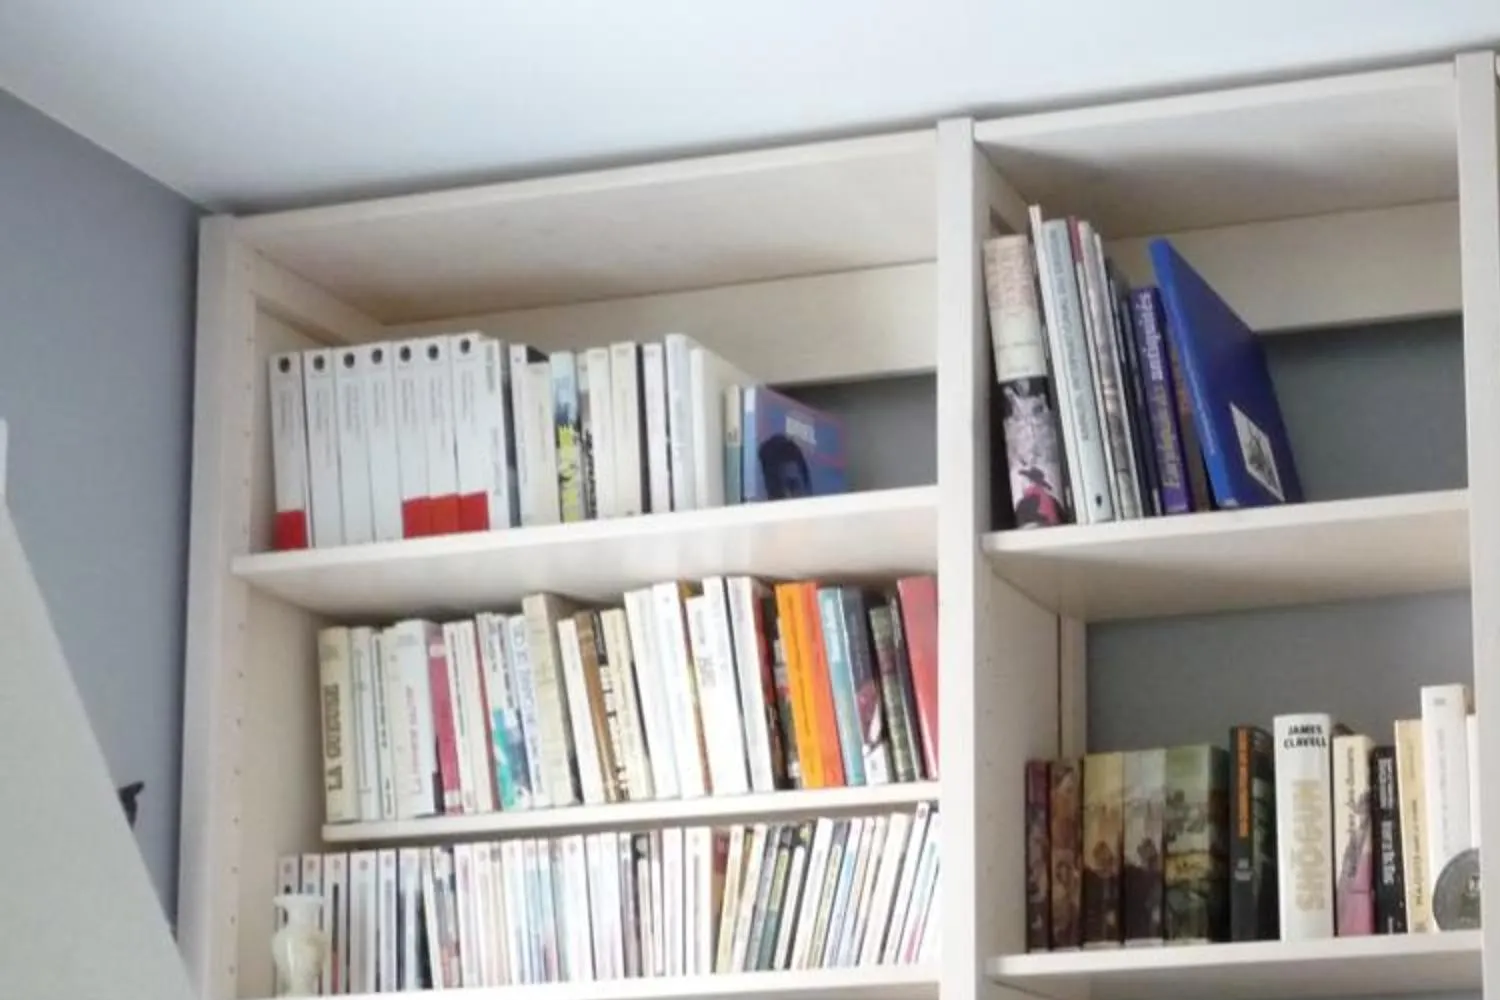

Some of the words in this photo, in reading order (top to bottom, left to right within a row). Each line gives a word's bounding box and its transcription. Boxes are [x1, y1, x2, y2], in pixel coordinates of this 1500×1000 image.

[1288, 724, 1323, 735] JAMES
[1283, 735, 1327, 748] CLAVELL
[326, 765, 343, 792] LA
